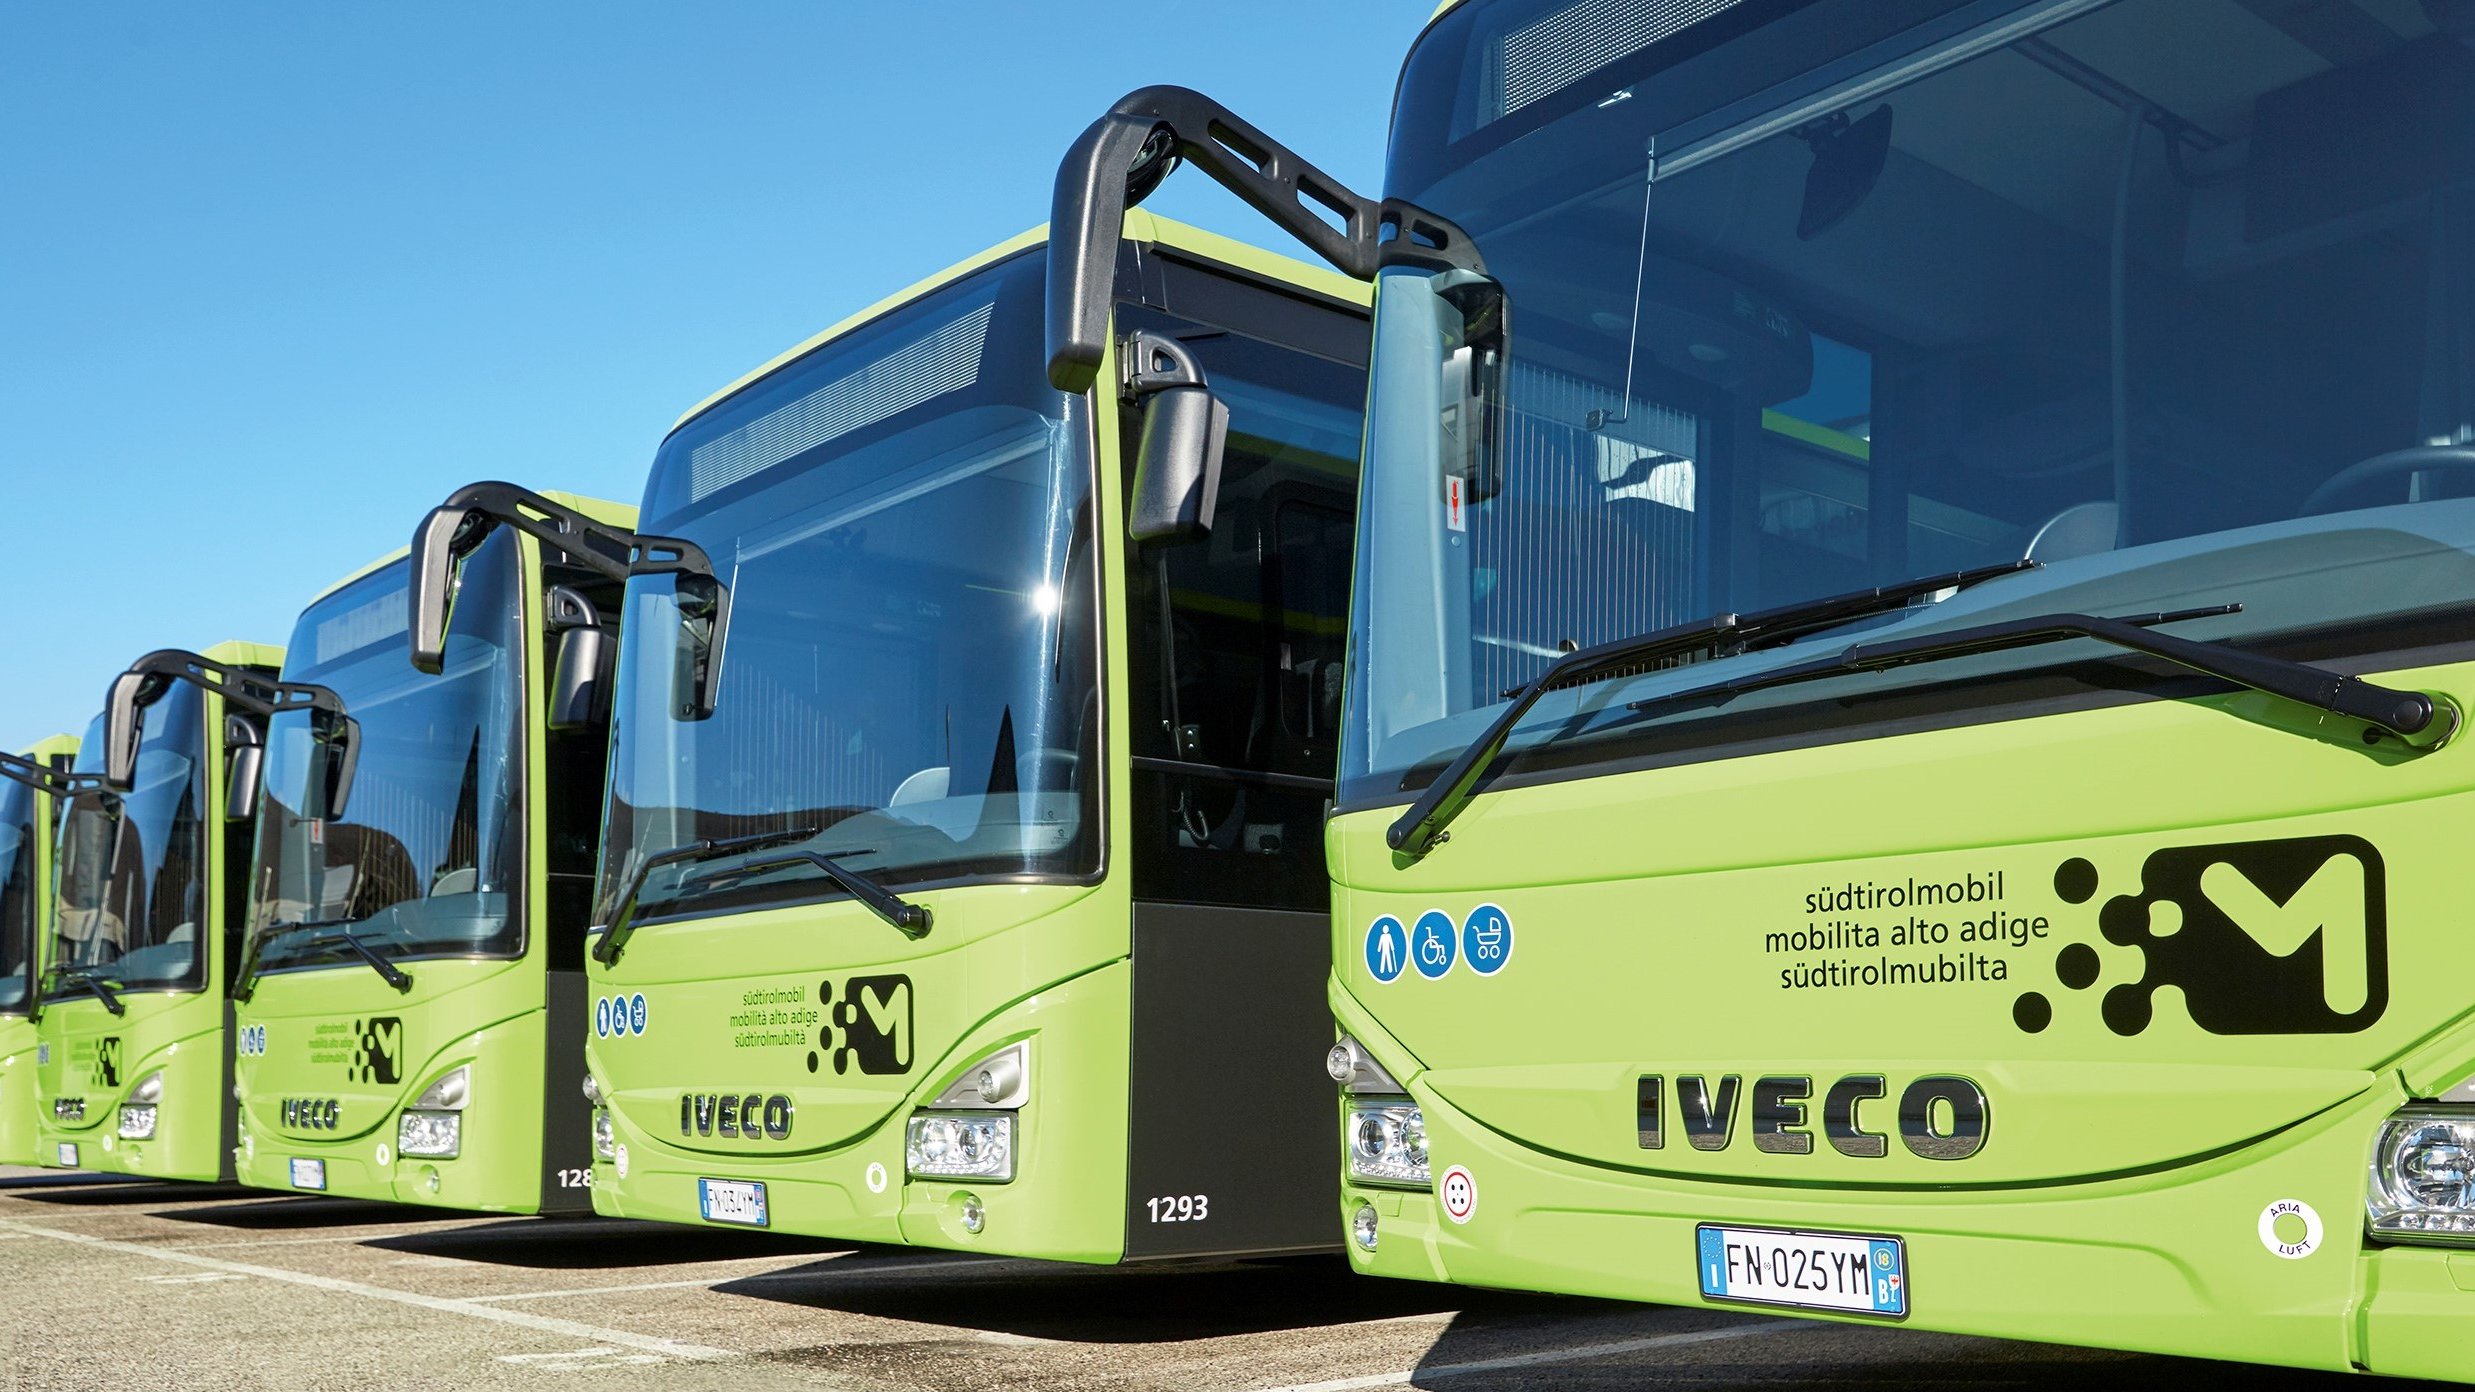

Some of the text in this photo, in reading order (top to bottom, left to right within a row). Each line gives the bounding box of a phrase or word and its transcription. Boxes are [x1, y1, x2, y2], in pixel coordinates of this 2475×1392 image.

[1805, 870, 2004, 914] südtirolmobil
[1765, 910, 2050, 953] mobilita alto adige
[1780, 951, 2008, 990] südtirolmubilta
[742, 985, 806, 1006] südtirolmobil
[729, 1006, 819, 1028] mobilità alto adige
[281, 1098, 339, 1130] IVECO
[680, 1093, 794, 1141] IVECO
[1636, 1073, 1992, 1161] IVECO
[1146, 1194, 1209, 1223] 1293
[2270, 1202, 2301, 1218] ARIA
[2278, 1240, 2311, 1256] LUFT
